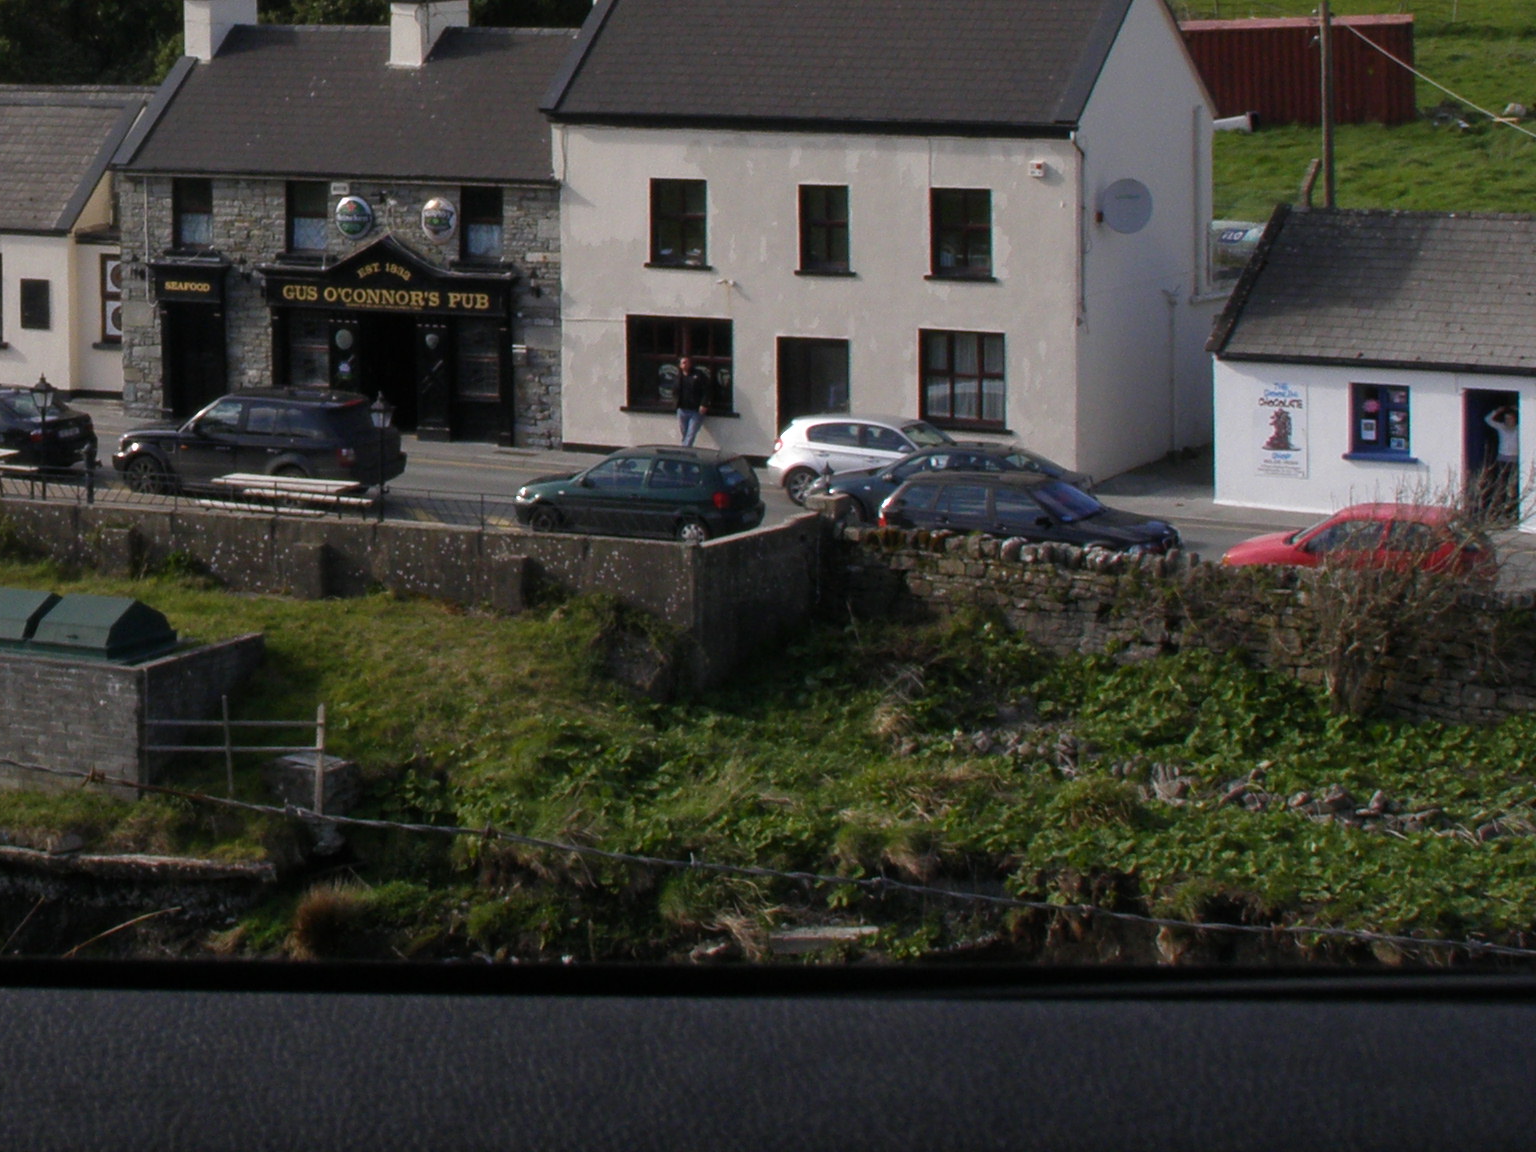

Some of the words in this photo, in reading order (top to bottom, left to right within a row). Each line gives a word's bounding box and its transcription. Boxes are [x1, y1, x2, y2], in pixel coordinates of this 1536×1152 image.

[385, 262, 411, 281] 1832
[165, 281, 210, 292] SEAFOOD
[283, 285, 317, 301] GUS
[323, 287, 440, 307] O'CONNOR'S
[448, 292, 490, 309] PUB
